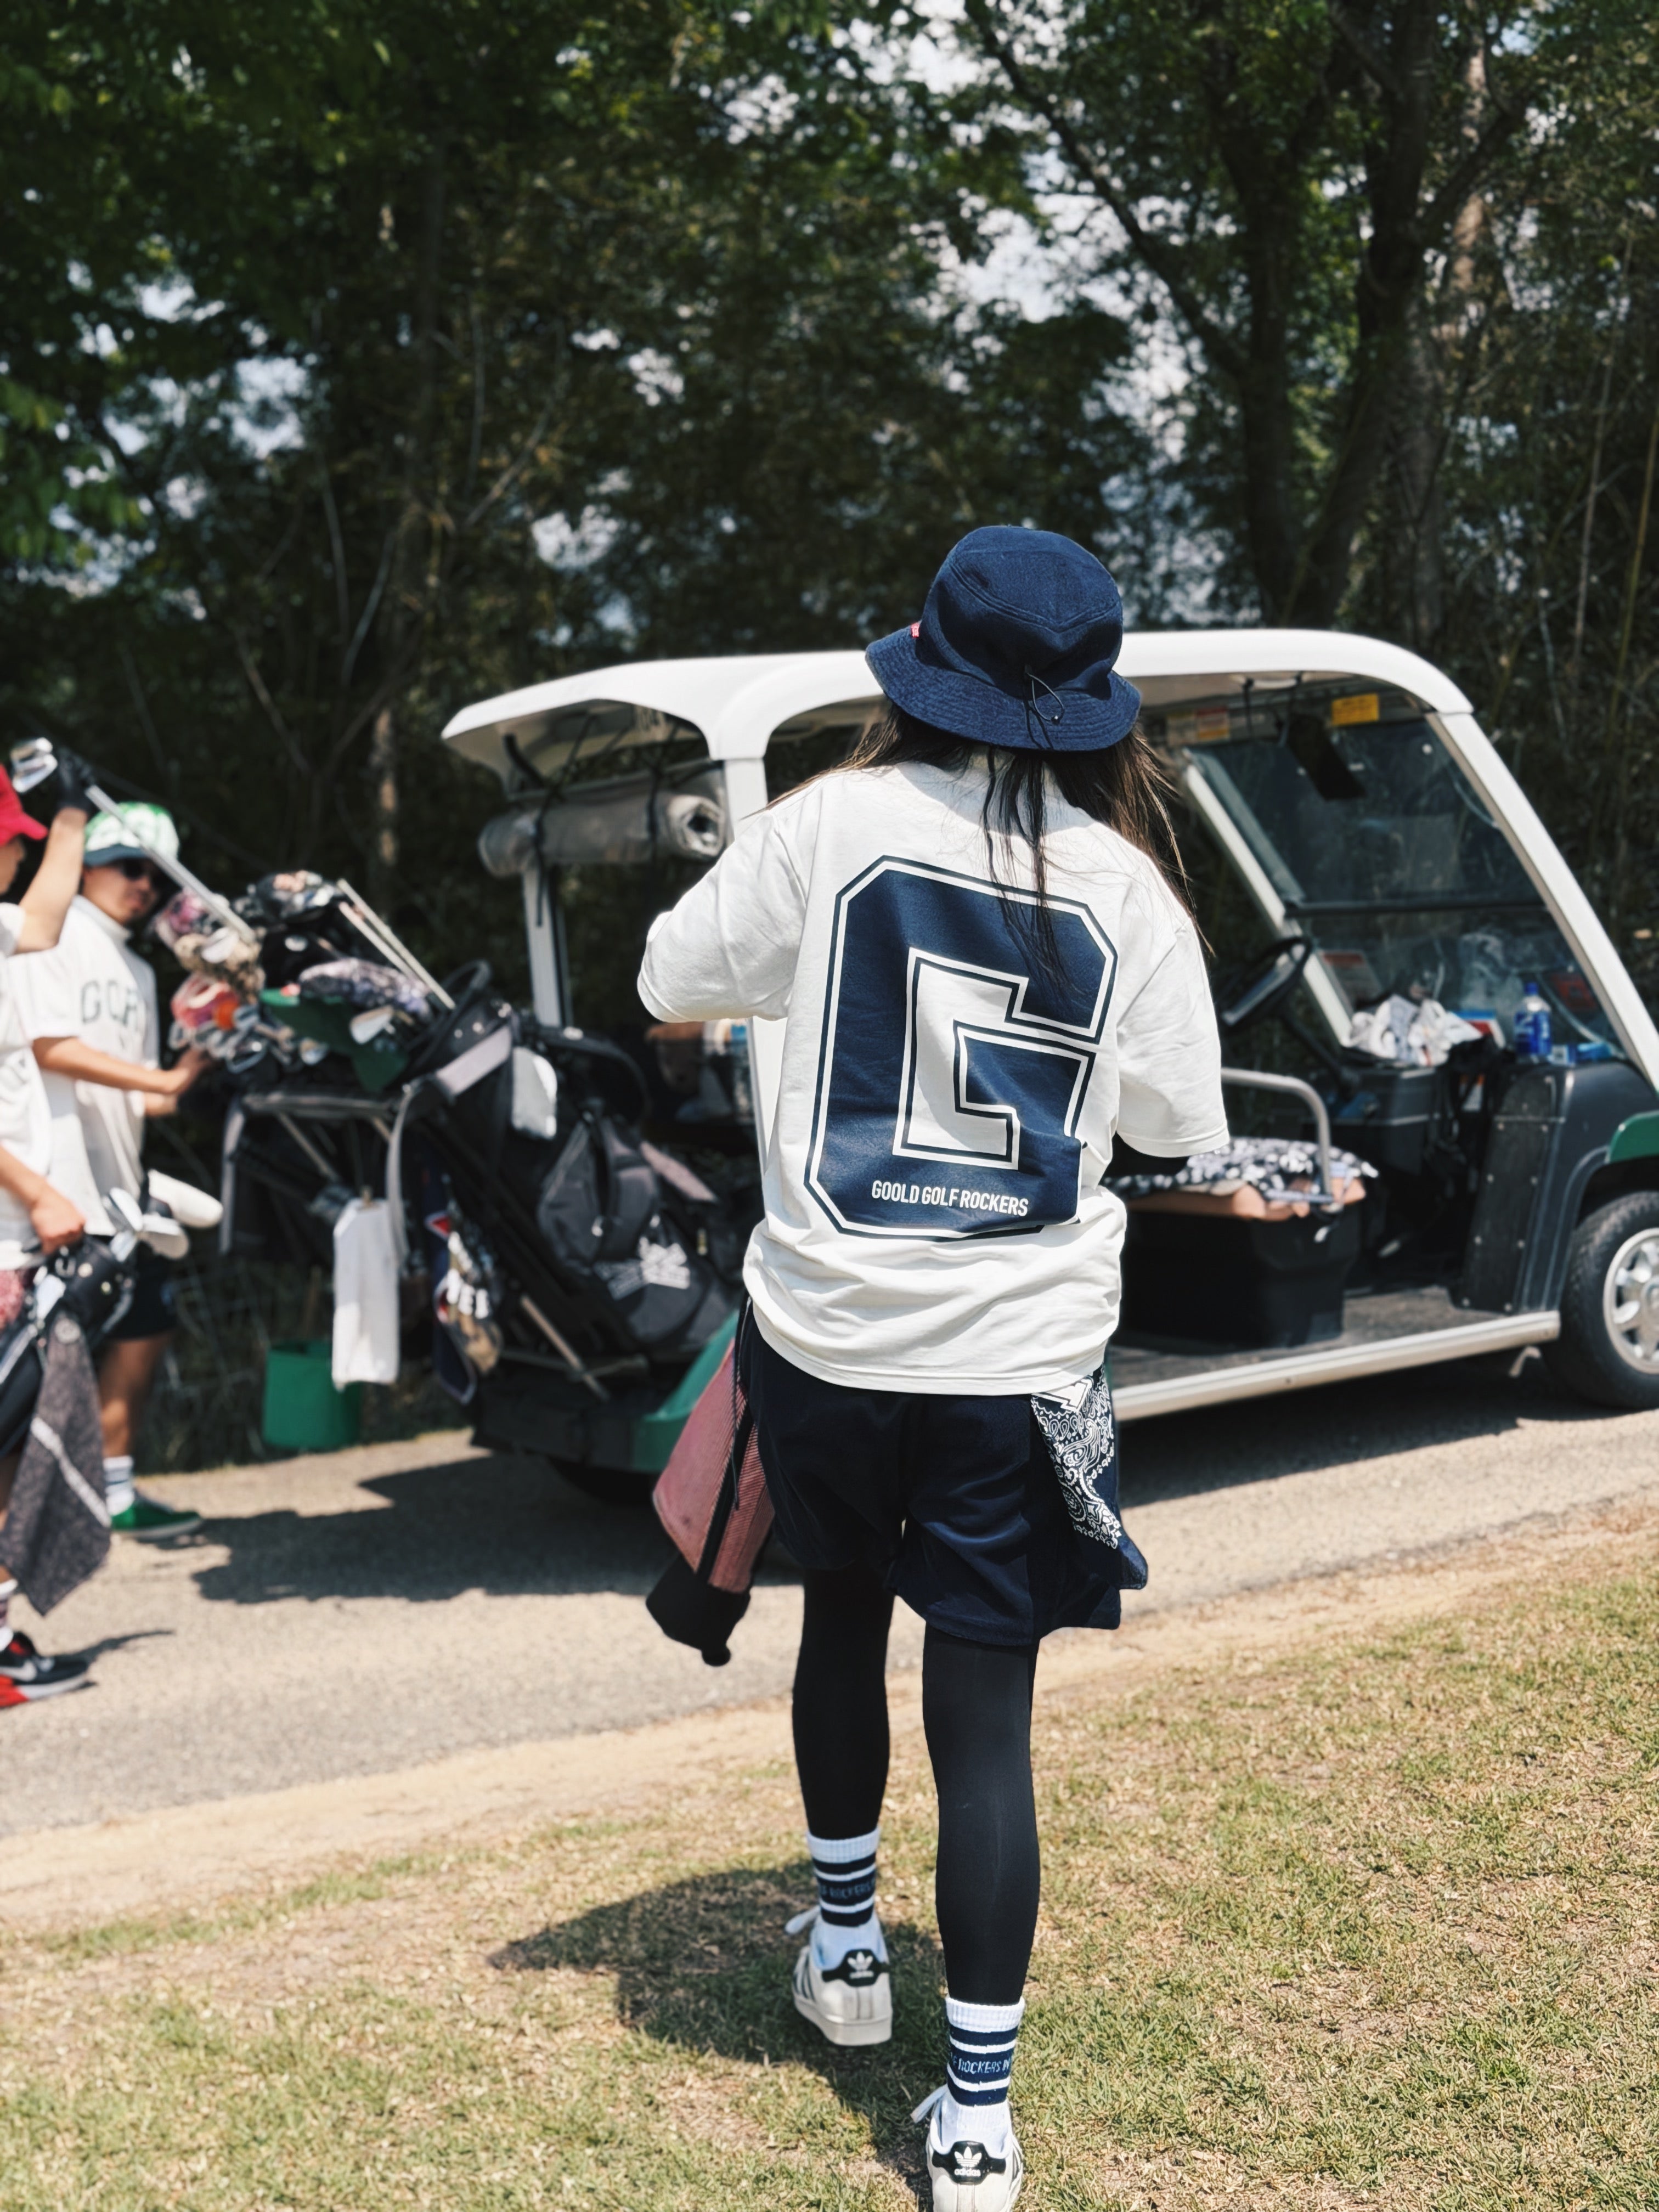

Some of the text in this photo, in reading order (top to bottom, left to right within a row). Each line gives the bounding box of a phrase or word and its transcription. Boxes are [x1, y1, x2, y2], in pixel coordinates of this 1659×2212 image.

[804, 855, 1118, 1240] G
[871, 1180, 1029, 1216] GOOLD GOLF ROCKERS
[954, 2168, 981, 2177] adidas
